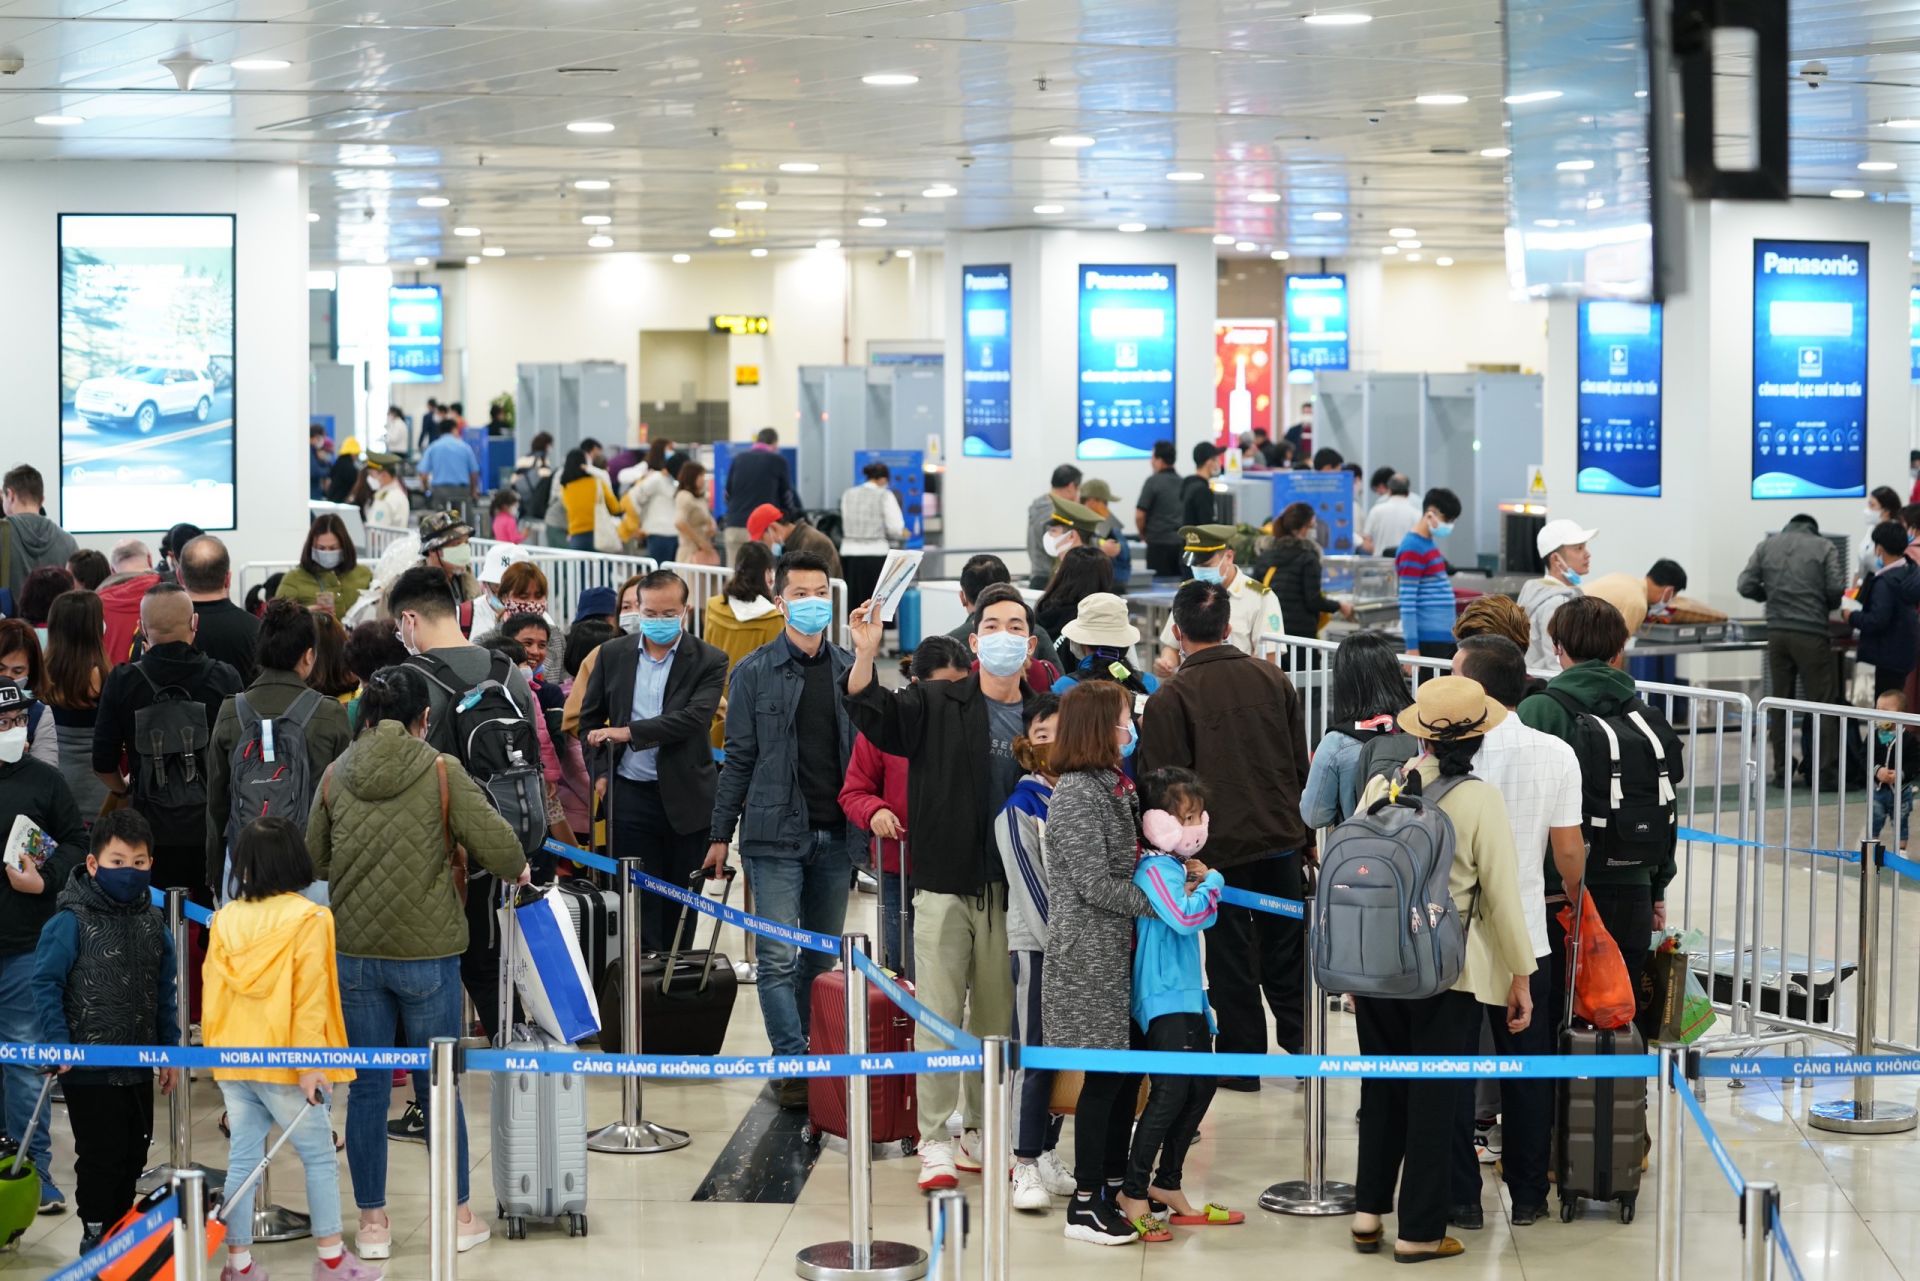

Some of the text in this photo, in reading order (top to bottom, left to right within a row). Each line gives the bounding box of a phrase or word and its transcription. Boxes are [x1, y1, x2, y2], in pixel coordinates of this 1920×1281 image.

[1763, 251, 1859, 276] Panasonic
[758, 921, 792, 940] INTERNATIONAL
[793, 931, 812, 944] AIRPORT
[21, 1044, 36, 1060] TẾ
[38, 1046, 61, 1063] NỘI
[64, 1047, 85, 1061] BÀI
[139, 1051, 169, 1063] N.I.A
[220, 1051, 264, 1065] NOIBAI
[267, 1051, 369, 1065] INTERNATIONAL
[372, 1052, 428, 1065] AIRPORT
[505, 1057, 539, 1070] N.I.A
[572, 1056, 613, 1073] CẢNG
[616, 1059, 657, 1074] HÀNG
[661, 1061, 710, 1075] KHÔNG
[714, 1058, 754, 1075] QUỐC
[758, 1057, 775, 1074] TẾ
[778, 1060, 803, 1075] NỘI
[807, 1057, 831, 1072] BÀI
[860, 1058, 894, 1070] N.I.A
[927, 1055, 975, 1068] NOIBAI
[1319, 1059, 1522, 1074] AN NINH HÀNG KHÔNG NỘI BÀI
[1730, 1058, 1920, 1075] N.I.A CẢNG HÀNG KHÔNG
